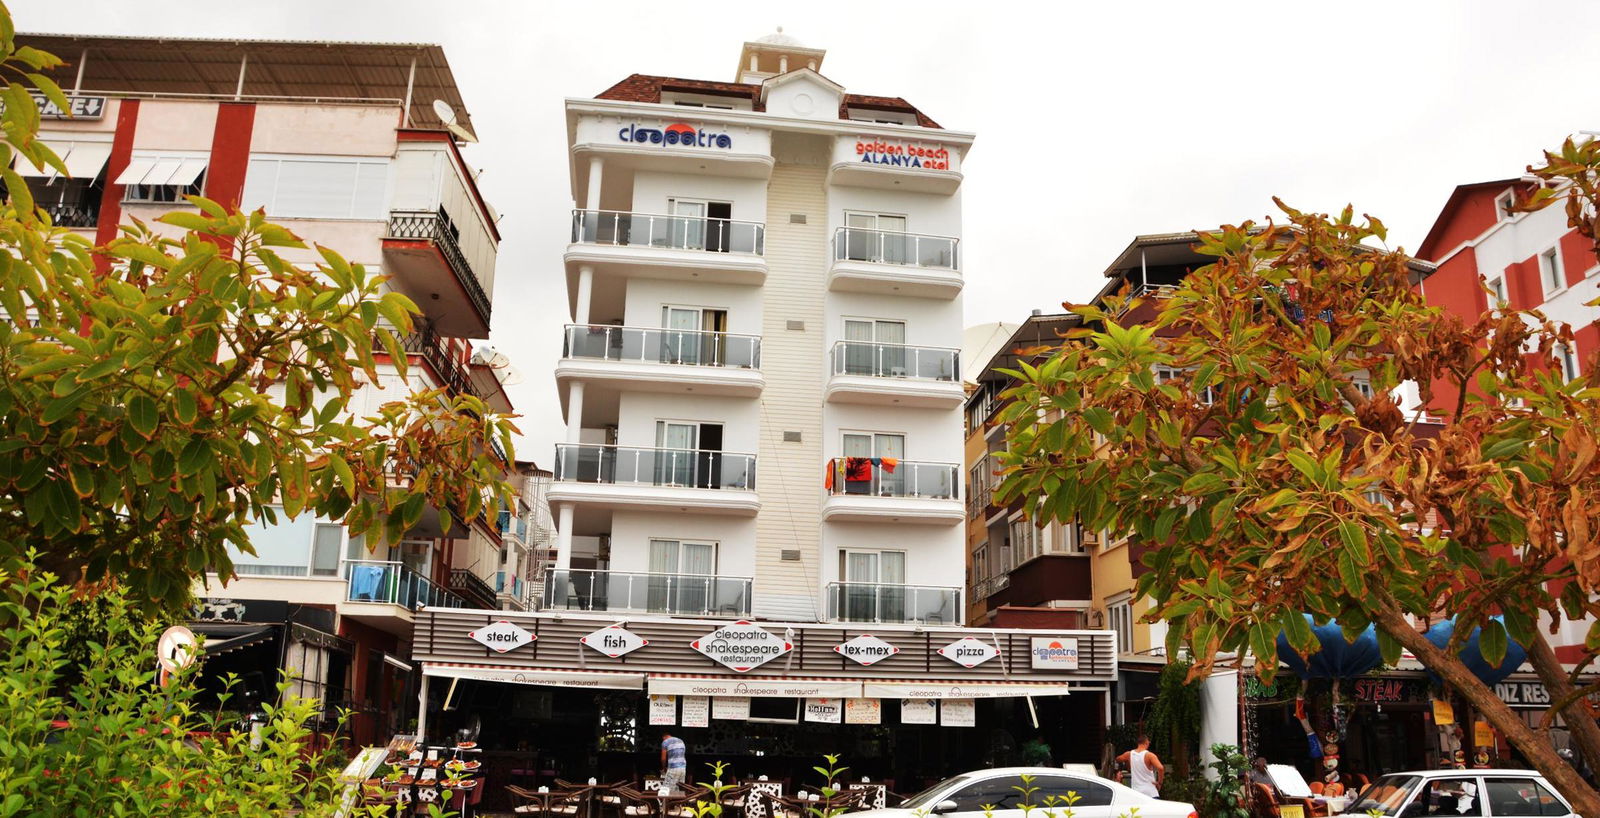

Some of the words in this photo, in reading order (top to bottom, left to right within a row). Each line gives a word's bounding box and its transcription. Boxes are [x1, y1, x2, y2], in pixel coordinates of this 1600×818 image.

[856, 140, 903, 155] golden
[907, 143, 949, 159] beach
[861, 152, 921, 168] ALANYA
[923, 159, 949, 170] otel
[486, 631, 518, 643] steak
[715, 629, 768, 640] cleopatra
[603, 635, 627, 648] fish
[705, 639, 779, 654] shakespeare
[844, 643, 890, 655] tex-mex
[956, 645, 984, 658] pizza
[720, 654, 764, 664] restaurant
[692, 686, 727, 694] cleopatra
[734, 682, 778, 695] shakespeare
[784, 687, 819, 695] restaurant
[909, 689, 942, 697] cleopatra
[1355, 679, 1403, 701] STEAK
